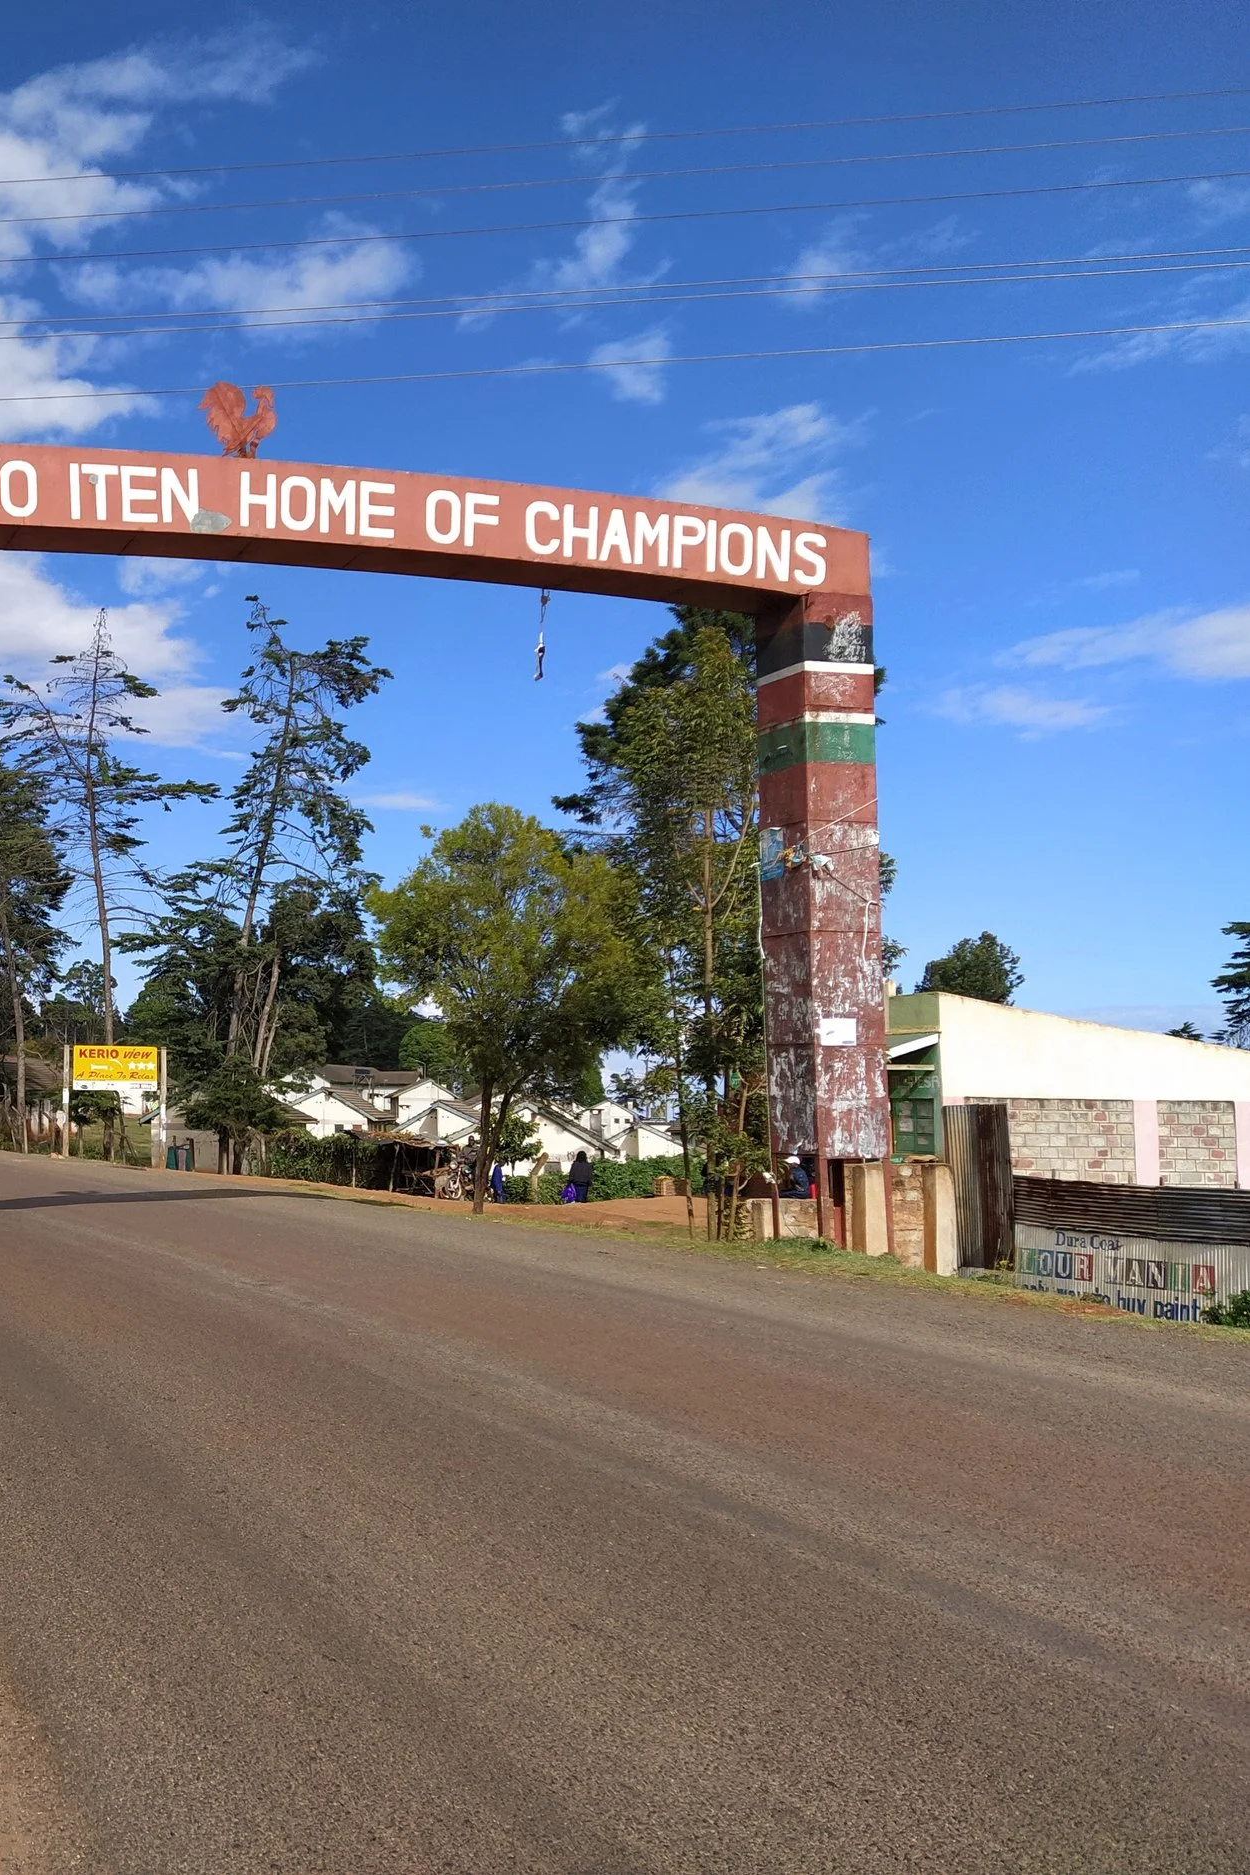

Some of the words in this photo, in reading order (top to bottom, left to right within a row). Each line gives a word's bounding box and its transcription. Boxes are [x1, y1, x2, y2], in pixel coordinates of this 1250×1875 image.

[69, 462, 200, 525] ITEN
[239, 471, 396, 539] HOME
[425, 489, 500, 547] OF
[525, 500, 827, 586] CHAMPIONS
[79, 1048, 120, 1059] KERIO
[123, 1048, 152, 1059] view
[75, 1071, 84, 1080] A
[87, 1071, 113, 1079] Place
[116, 1071, 127, 1079] To
[1054, 1231, 1086, 1249] Dura
[1090, 1234, 1121, 1251] Coat
[1117, 1289, 1146, 1315] buy
[1153, 1296, 1200, 1322] paint
